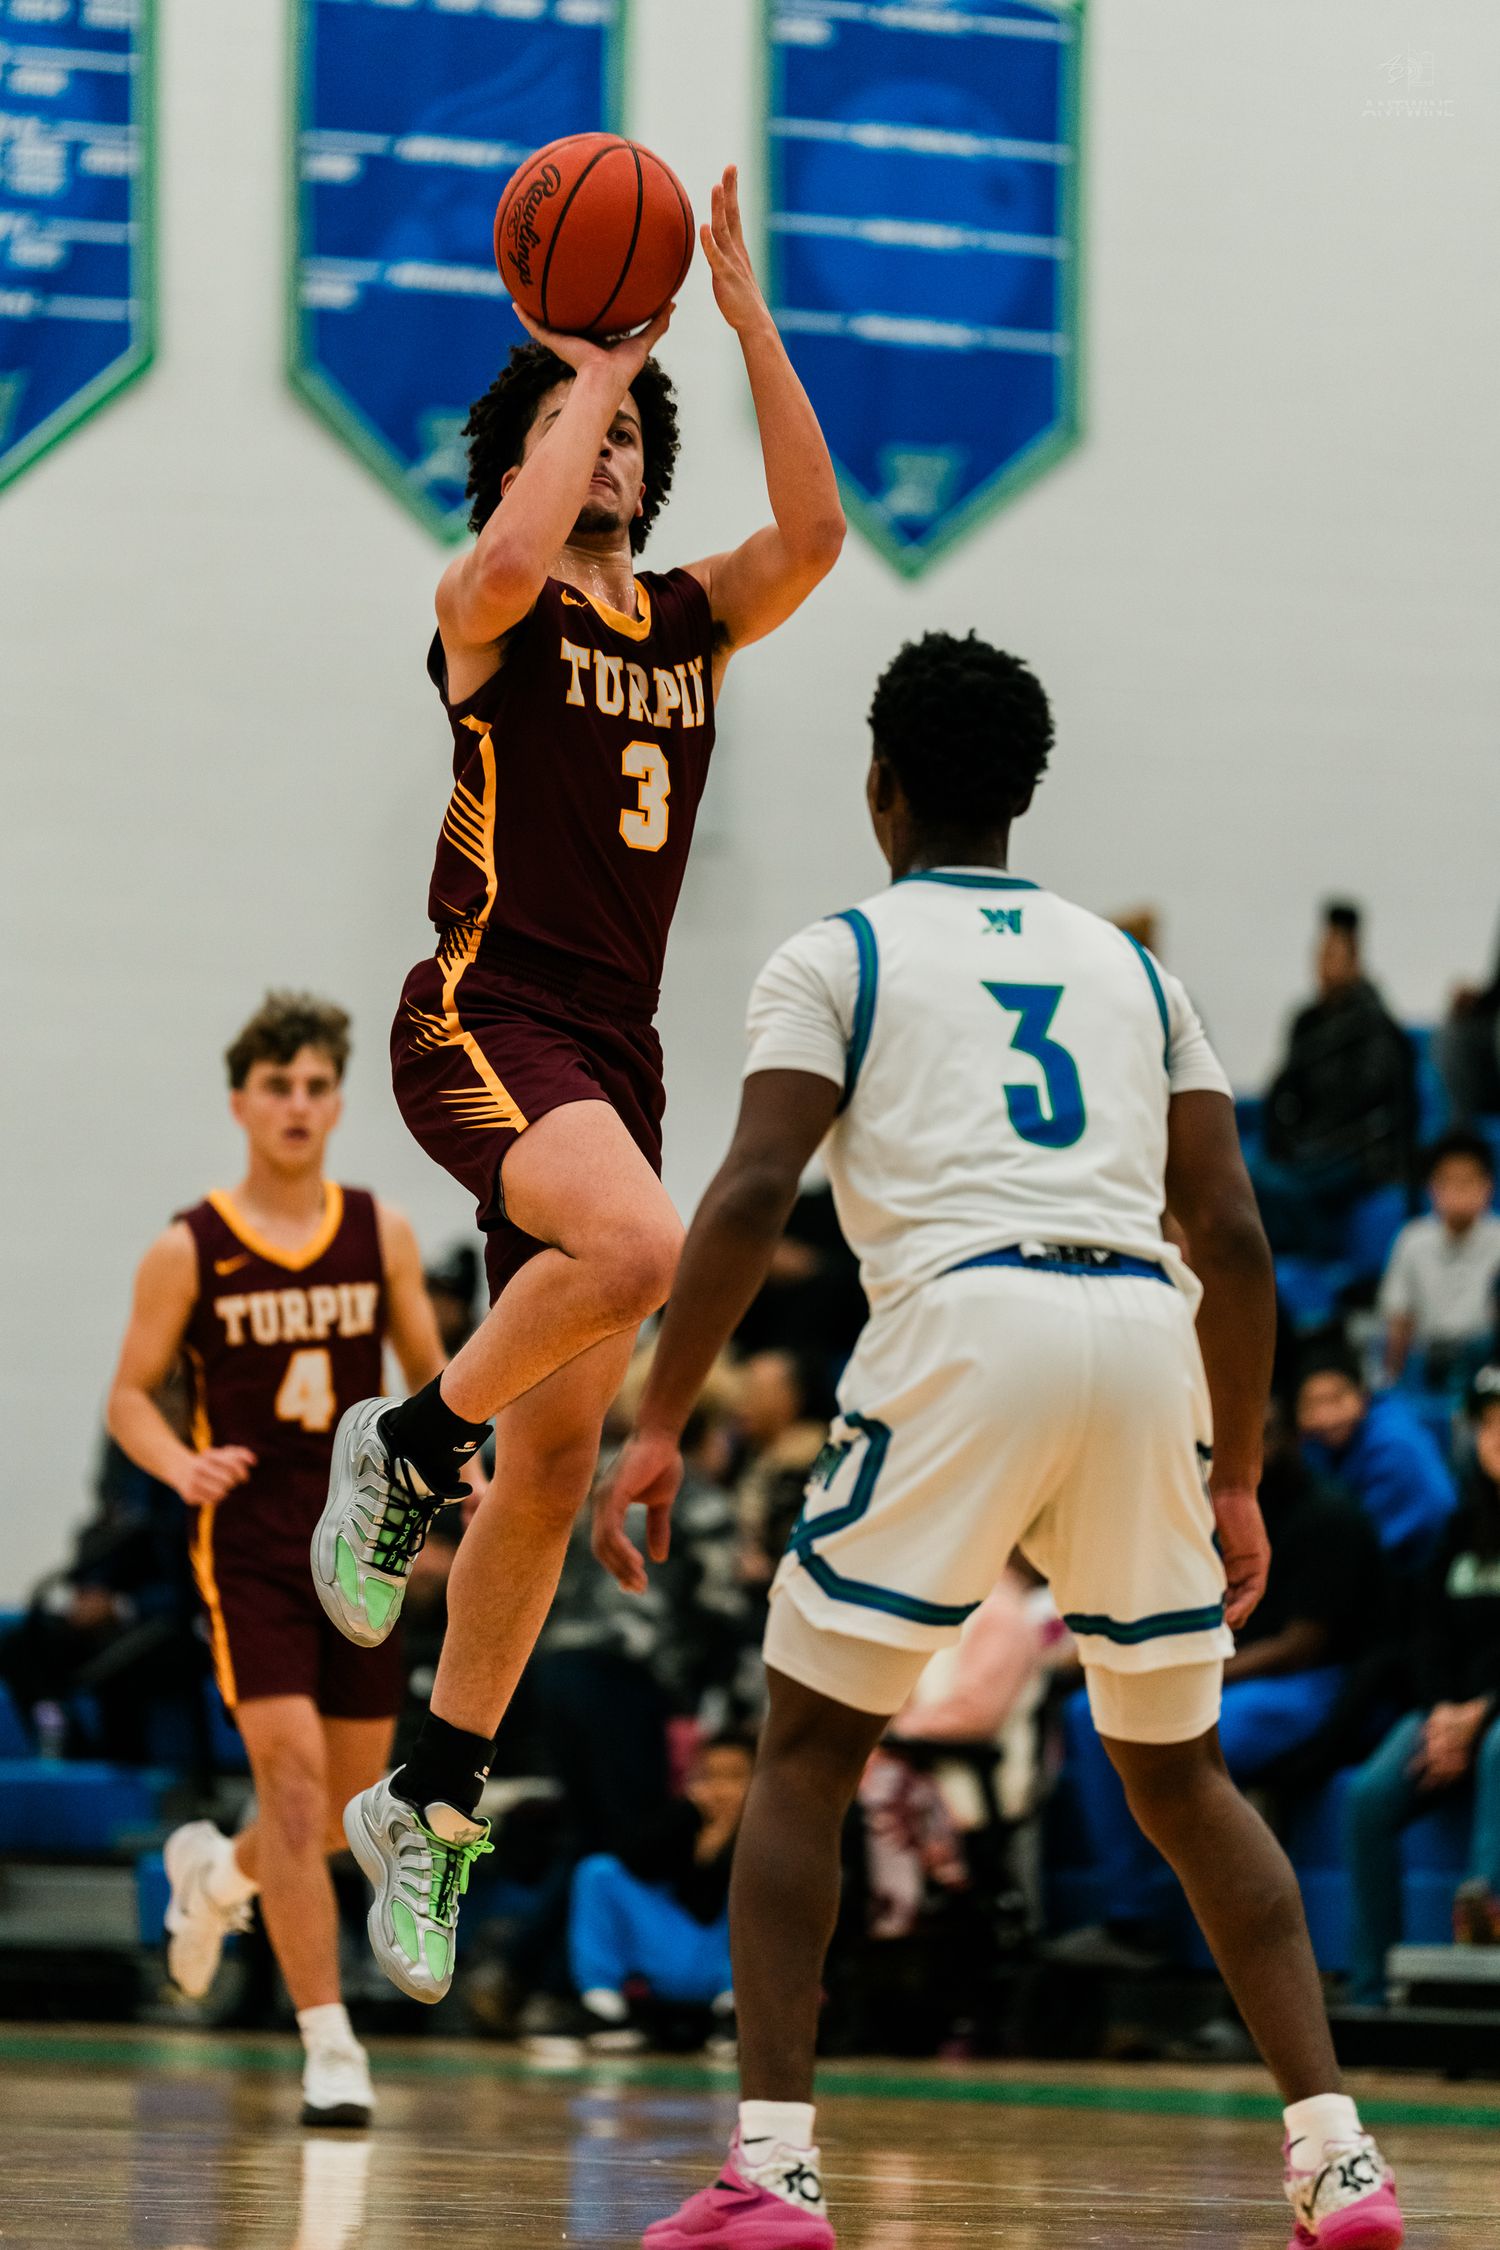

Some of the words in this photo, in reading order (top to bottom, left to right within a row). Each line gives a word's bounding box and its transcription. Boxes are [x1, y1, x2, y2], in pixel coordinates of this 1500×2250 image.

[508, 163, 562, 288] Rawlings
[560, 637, 705, 729] TURPIN
[618, 740, 671, 852] 3
[979, 981, 1086, 1149] 3
[214, 1281, 379, 1347] TURPIN
[275, 1347, 336, 1433] 4
